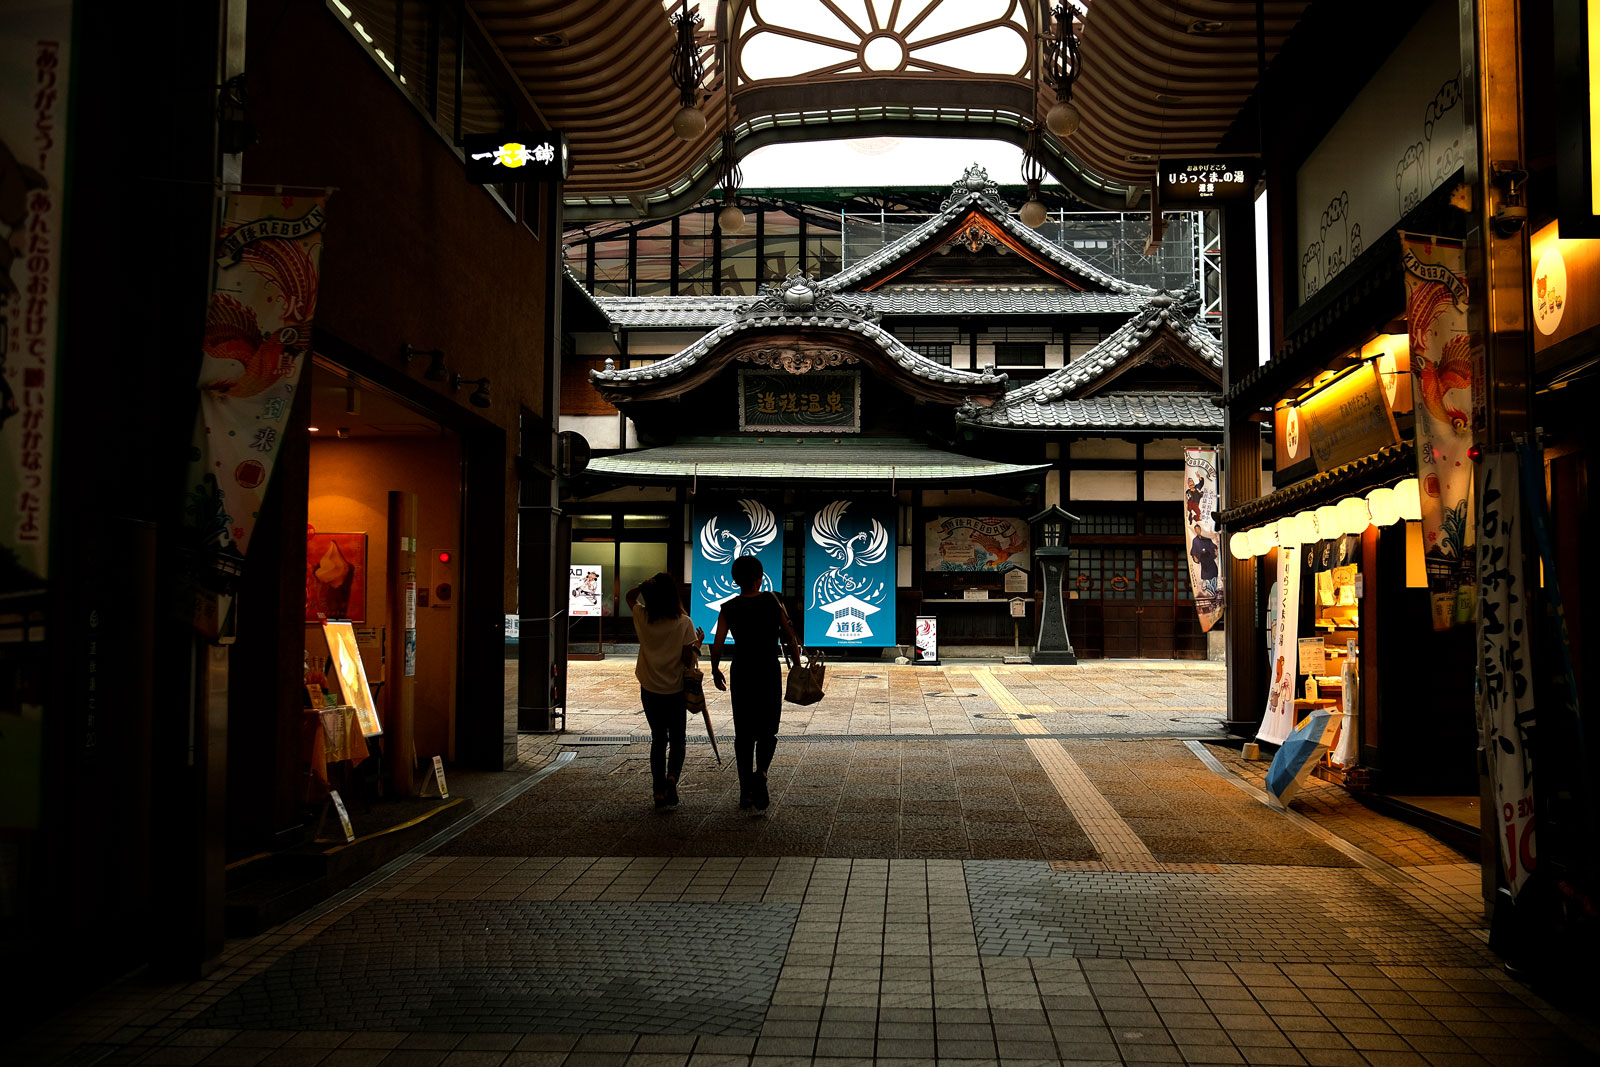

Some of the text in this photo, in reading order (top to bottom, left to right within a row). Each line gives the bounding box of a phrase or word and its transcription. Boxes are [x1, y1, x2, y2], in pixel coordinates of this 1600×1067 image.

[470, 142, 555, 166] 一六本舗
[756, 391, 844, 414] 道後温泉
[836, 621, 864, 633] 道後
